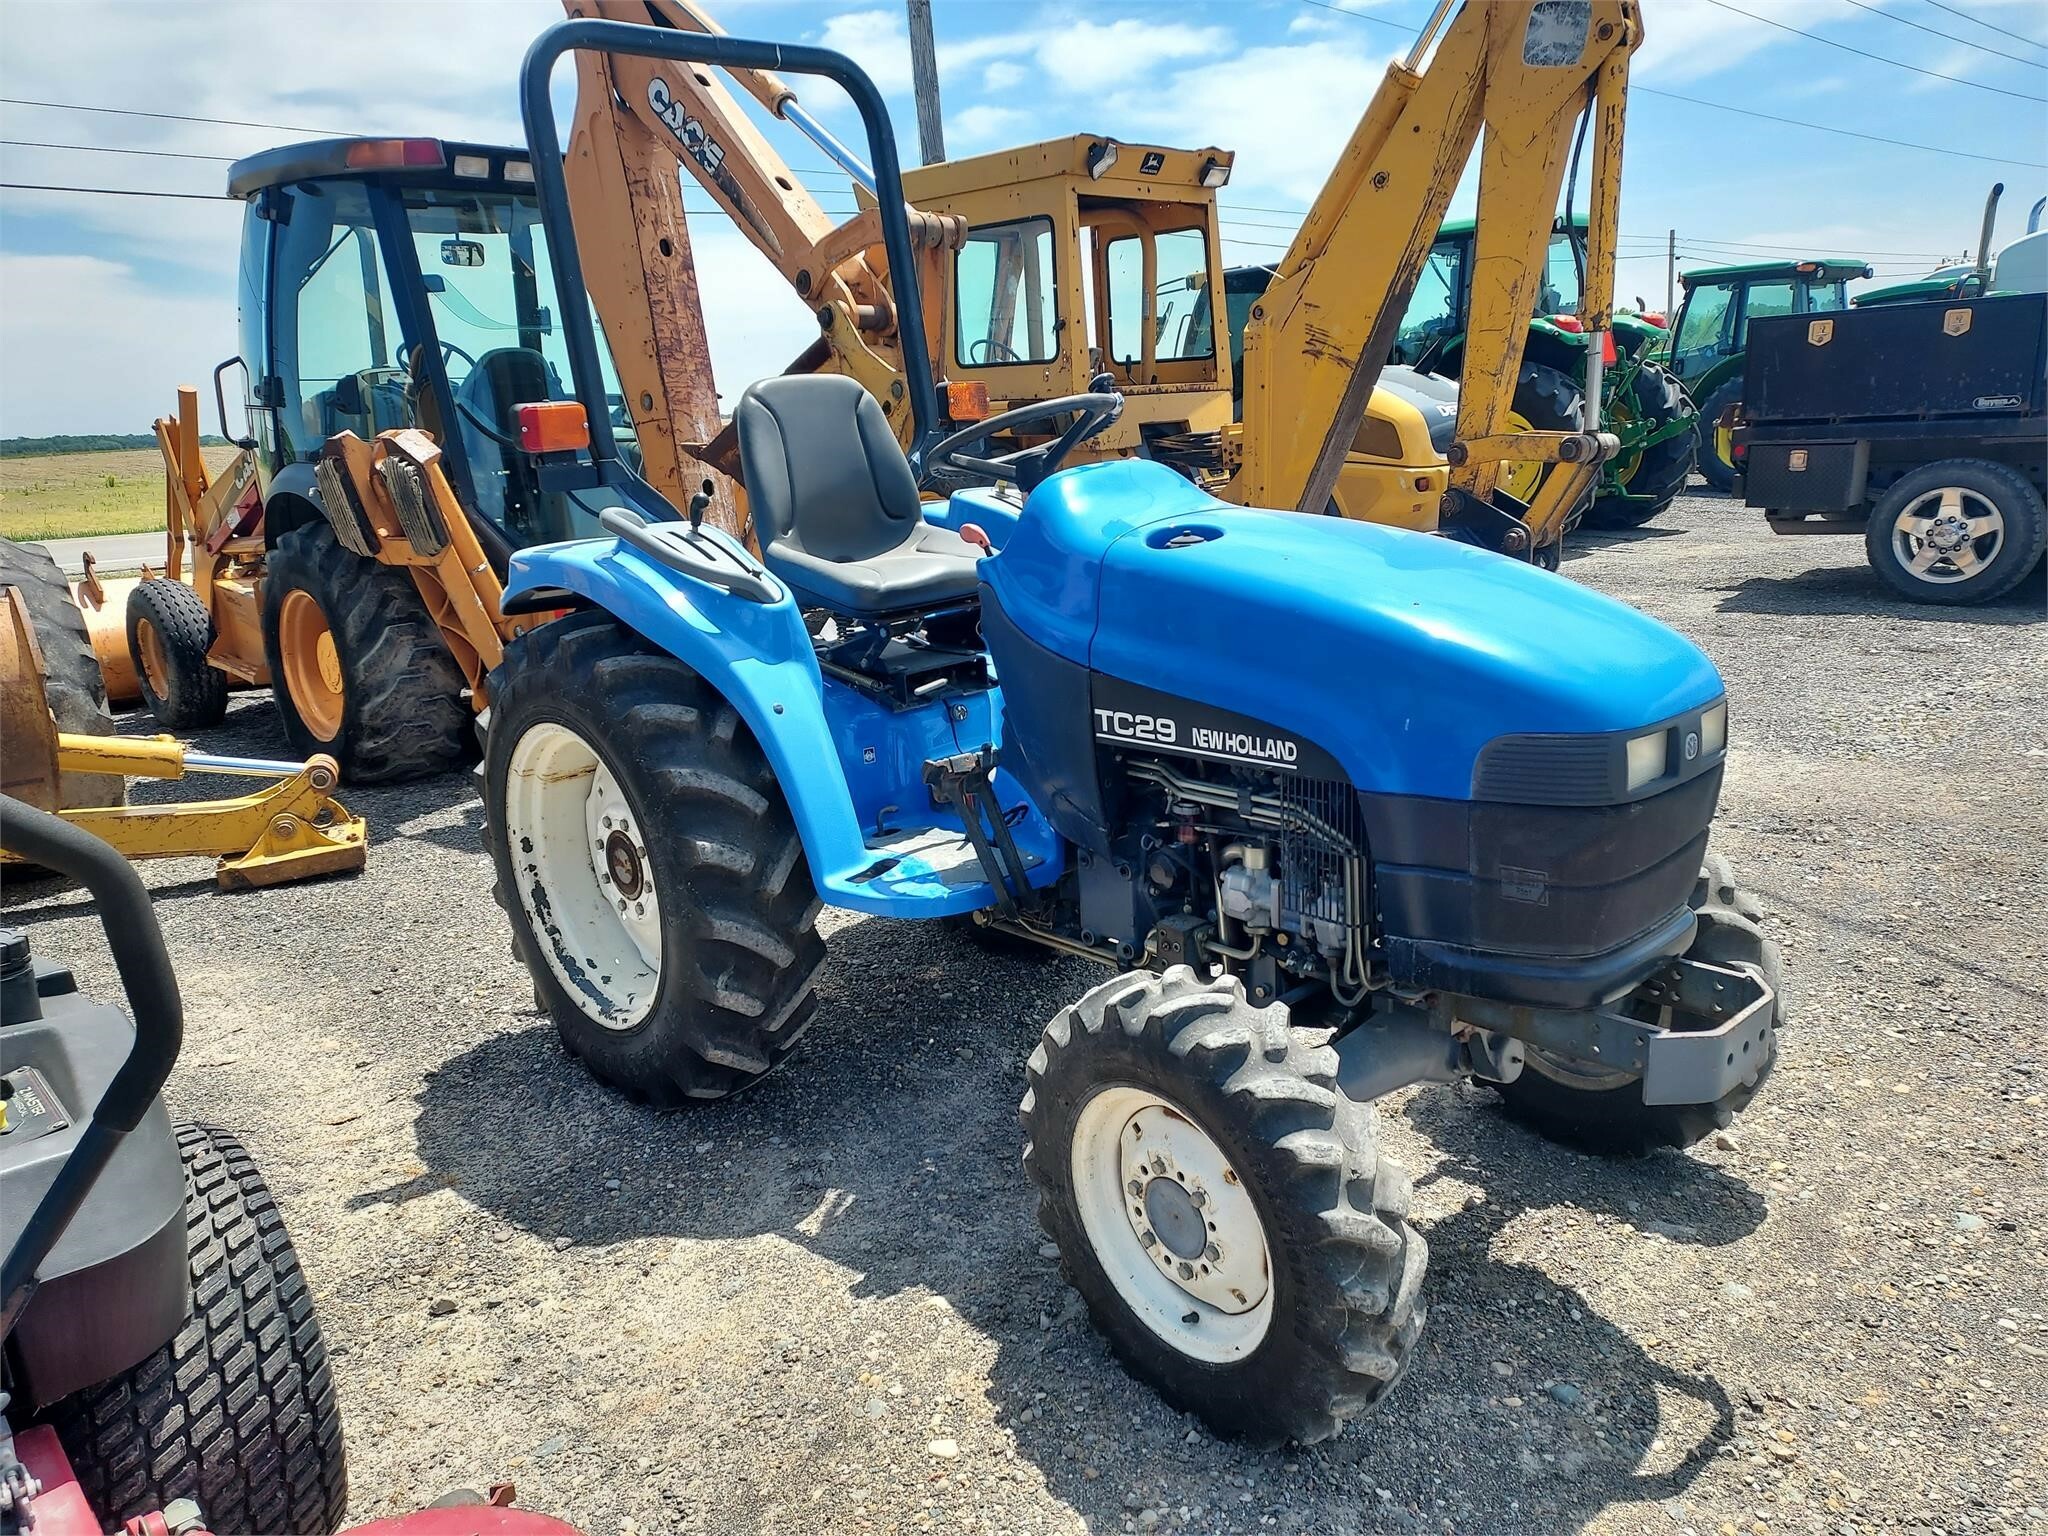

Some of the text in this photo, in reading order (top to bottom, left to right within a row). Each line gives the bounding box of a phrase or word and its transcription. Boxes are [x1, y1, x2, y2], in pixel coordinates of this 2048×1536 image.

[647, 77, 726, 177] CASE
[1094, 708, 1177, 743] TC29
[1192, 727, 1298, 762] NEW HOLLAND
